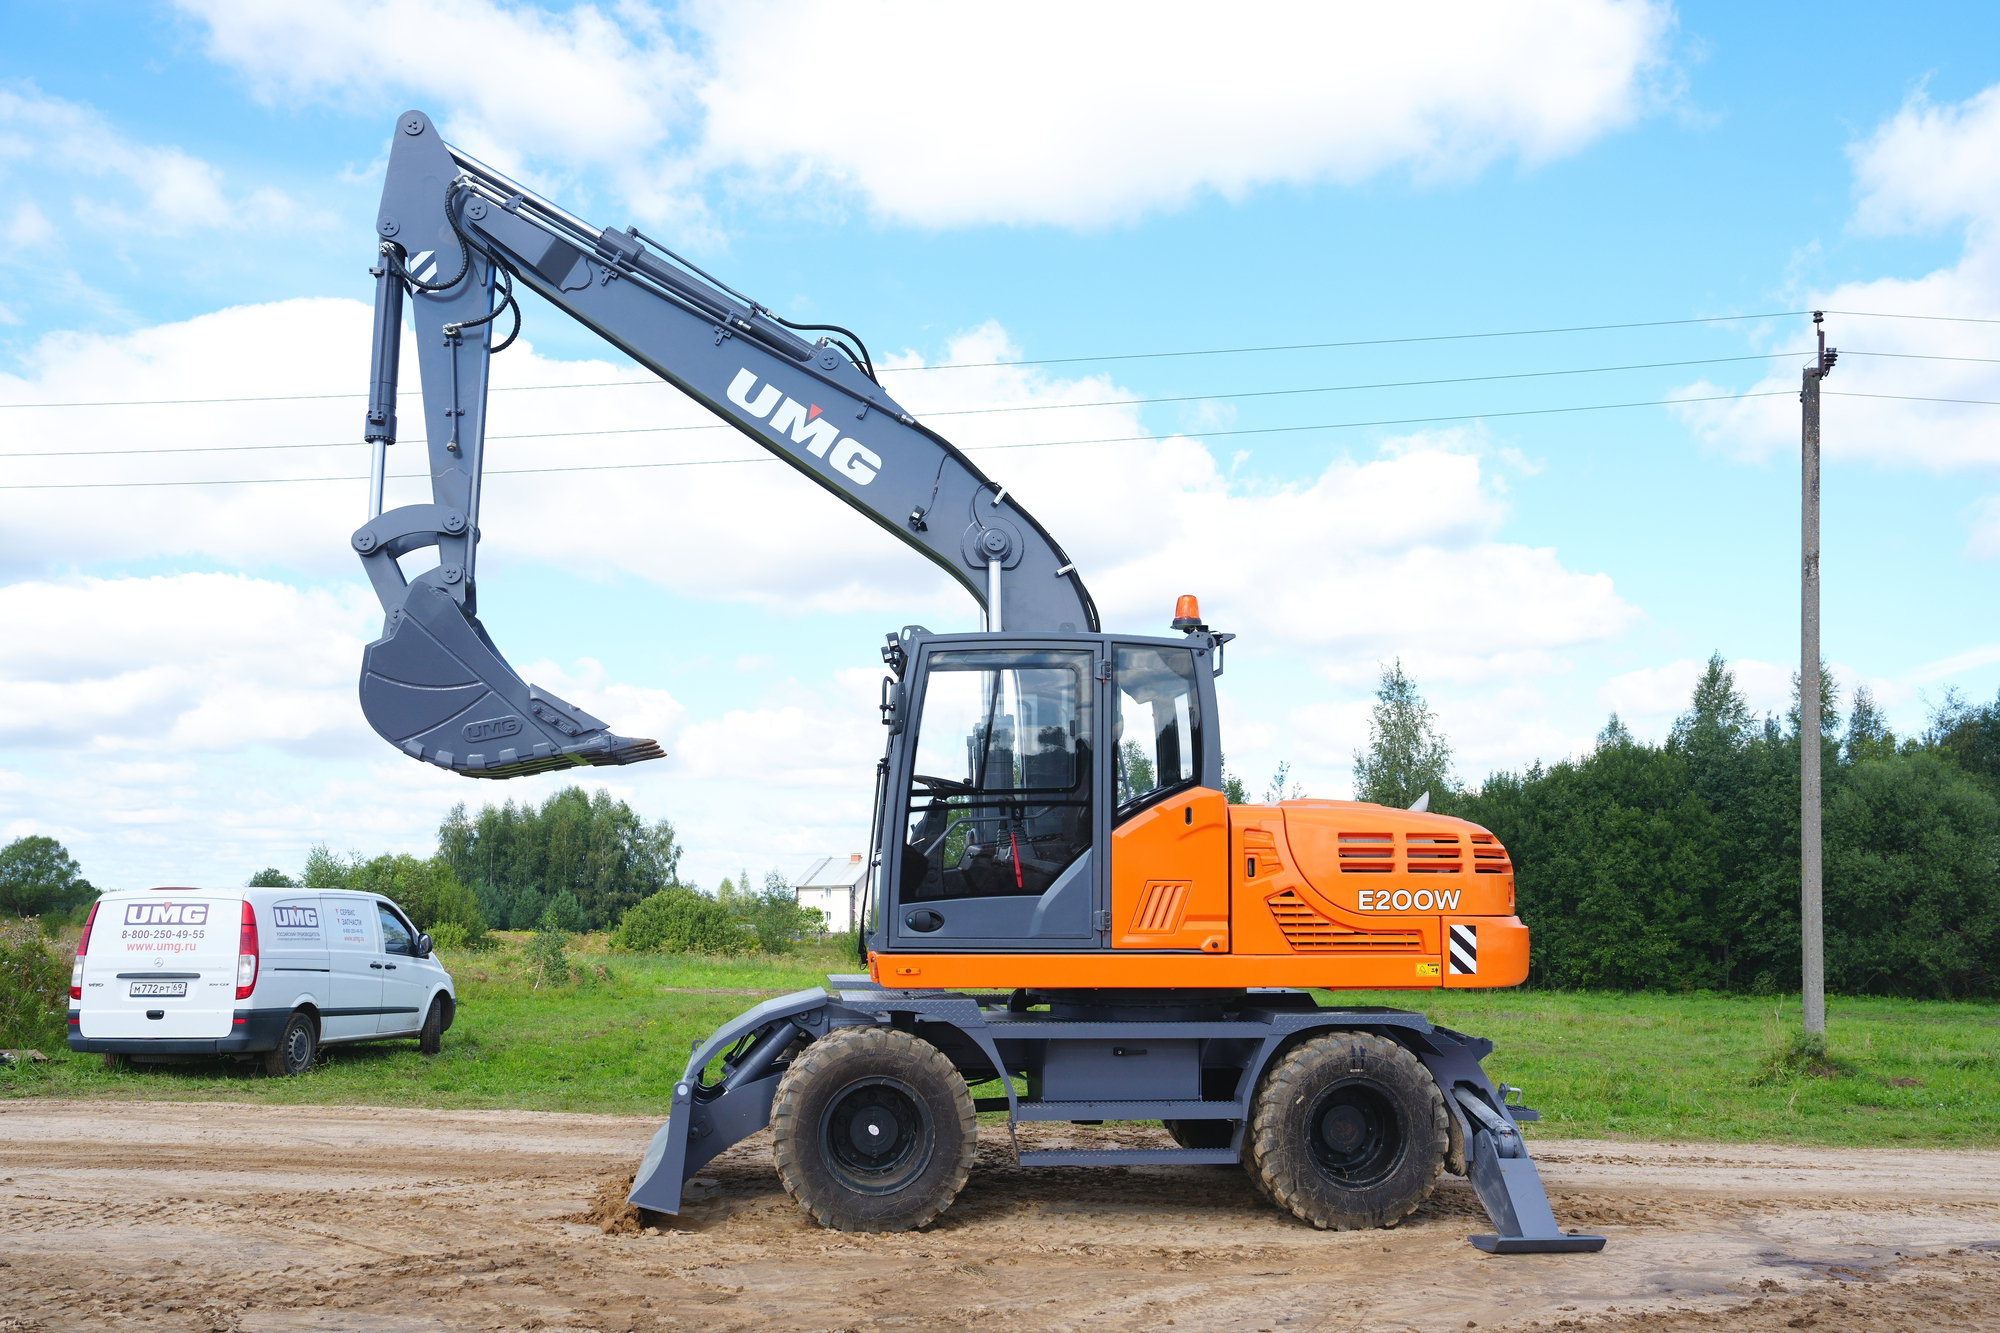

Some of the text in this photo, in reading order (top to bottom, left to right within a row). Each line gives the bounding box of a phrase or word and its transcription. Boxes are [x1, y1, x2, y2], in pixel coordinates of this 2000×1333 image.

[726, 367, 882, 486] UMG
[468, 719, 516, 738] UMG
[1358, 889, 1462, 911] E200W
[126, 905, 207, 924] UMG
[274, 908, 318, 926] UMG
[121, 929, 205, 939] 8-800-250-49-55
[126, 943, 197, 954] www.umg.ru
